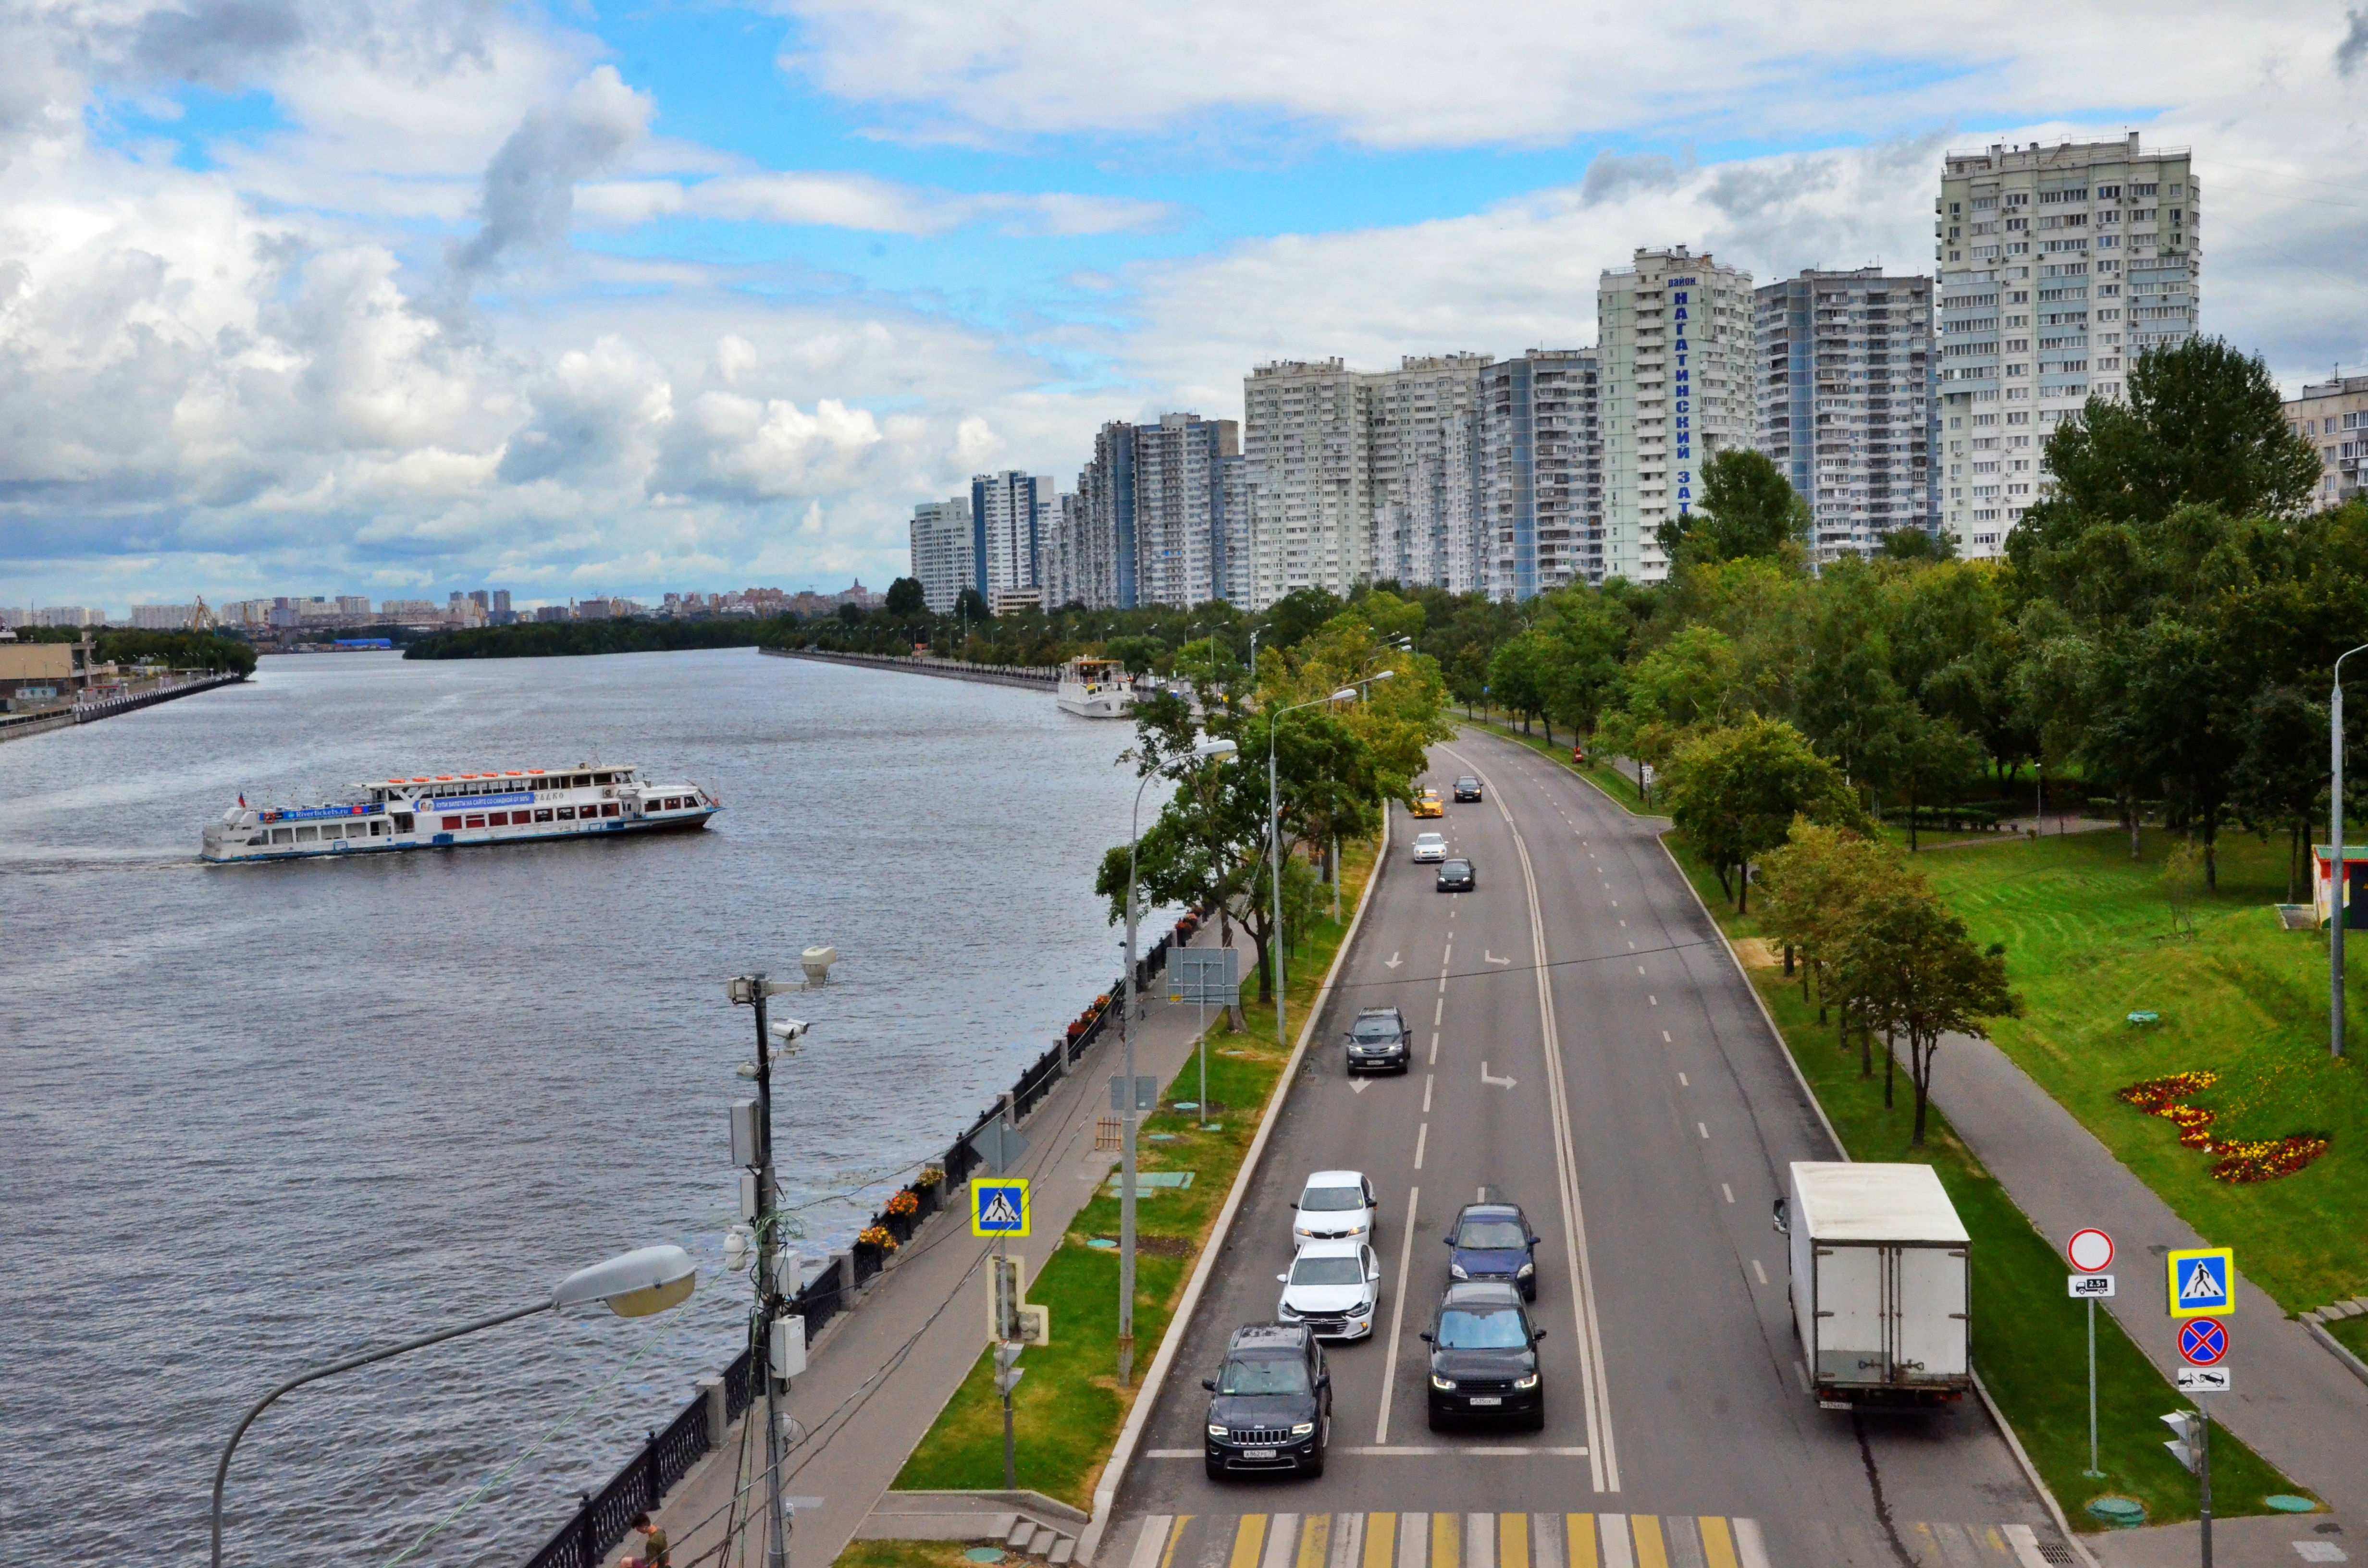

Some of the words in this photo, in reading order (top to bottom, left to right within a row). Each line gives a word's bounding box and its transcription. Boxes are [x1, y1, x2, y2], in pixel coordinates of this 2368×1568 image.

[1668, 276, 1696, 287] район
[1675, 292, 1690, 459] НАГАТИНСКИЙ
[1678, 471, 1691, 514] ЗАТ
[493, 796, 513, 804] СКИДКОЙ
[296, 809, 348, 817] Rivertickets.ru
